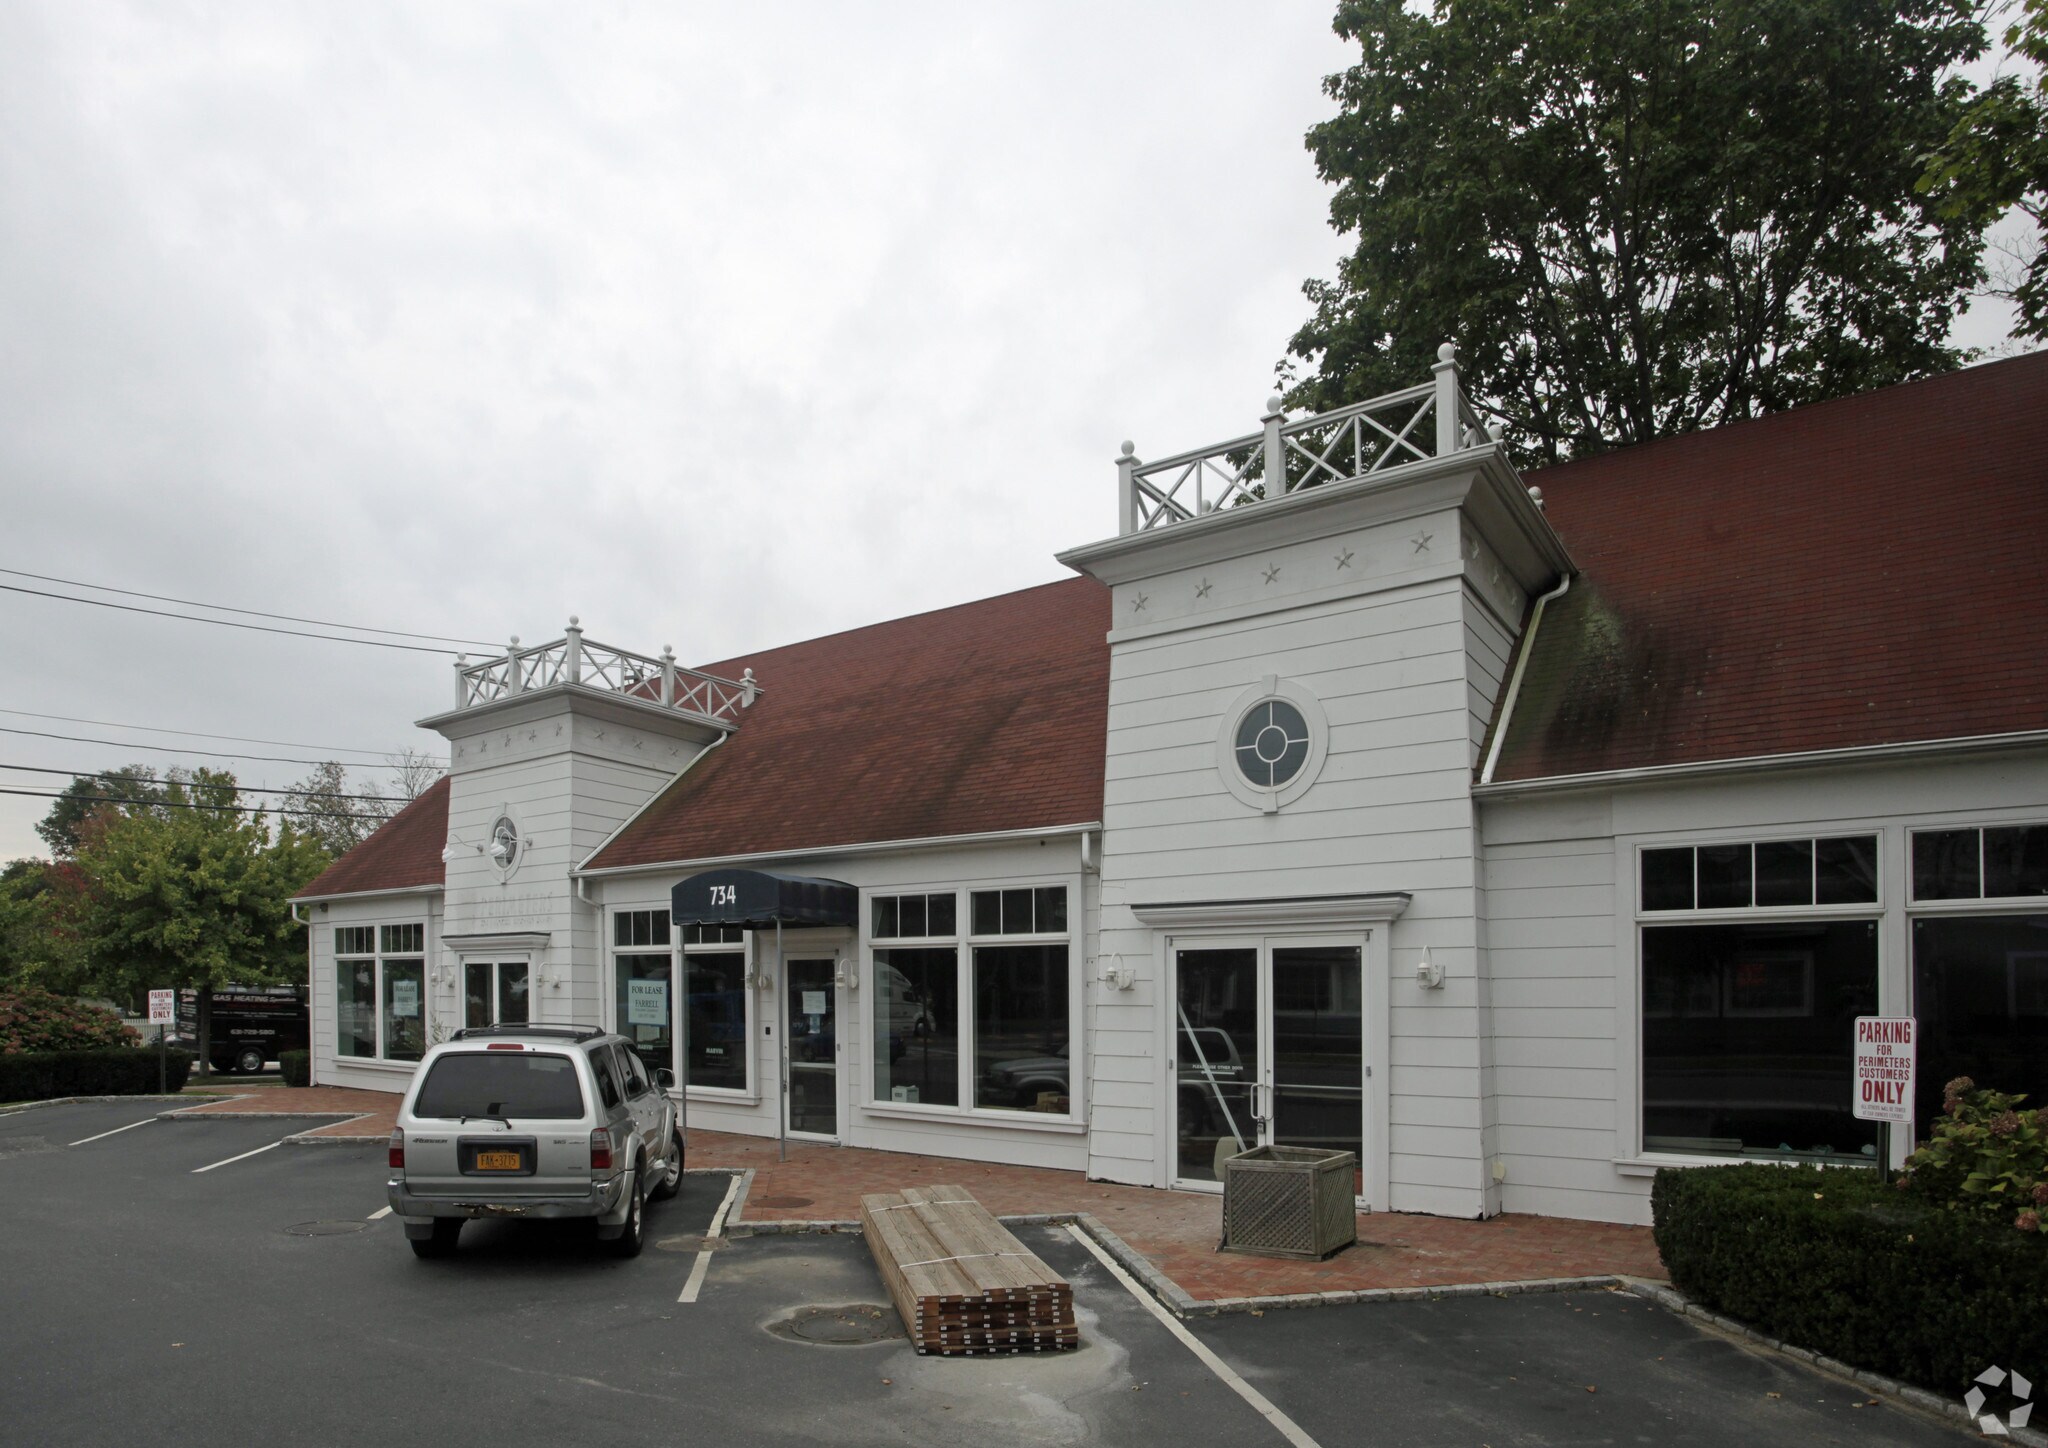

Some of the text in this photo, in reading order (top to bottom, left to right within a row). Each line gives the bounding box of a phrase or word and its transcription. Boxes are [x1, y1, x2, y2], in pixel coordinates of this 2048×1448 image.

[709, 885, 737, 906] 734
[151, 991, 172, 999] PARKING
[631, 985, 663, 995] FOR LEASE
[233, 995, 269, 1003] HEATING
[635, 1000, 659, 1008] FARRELL
[153, 1010, 171, 1019] ONLY
[1859, 1021, 1911, 1044] PARKING
[1876, 1044, 1893, 1056] FOR
[1858, 1056, 1911, 1069] PERIMETERS
[1859, 1067, 1910, 1081] CUSTOMERS
[1862, 1079, 1906, 1105] ONLY
